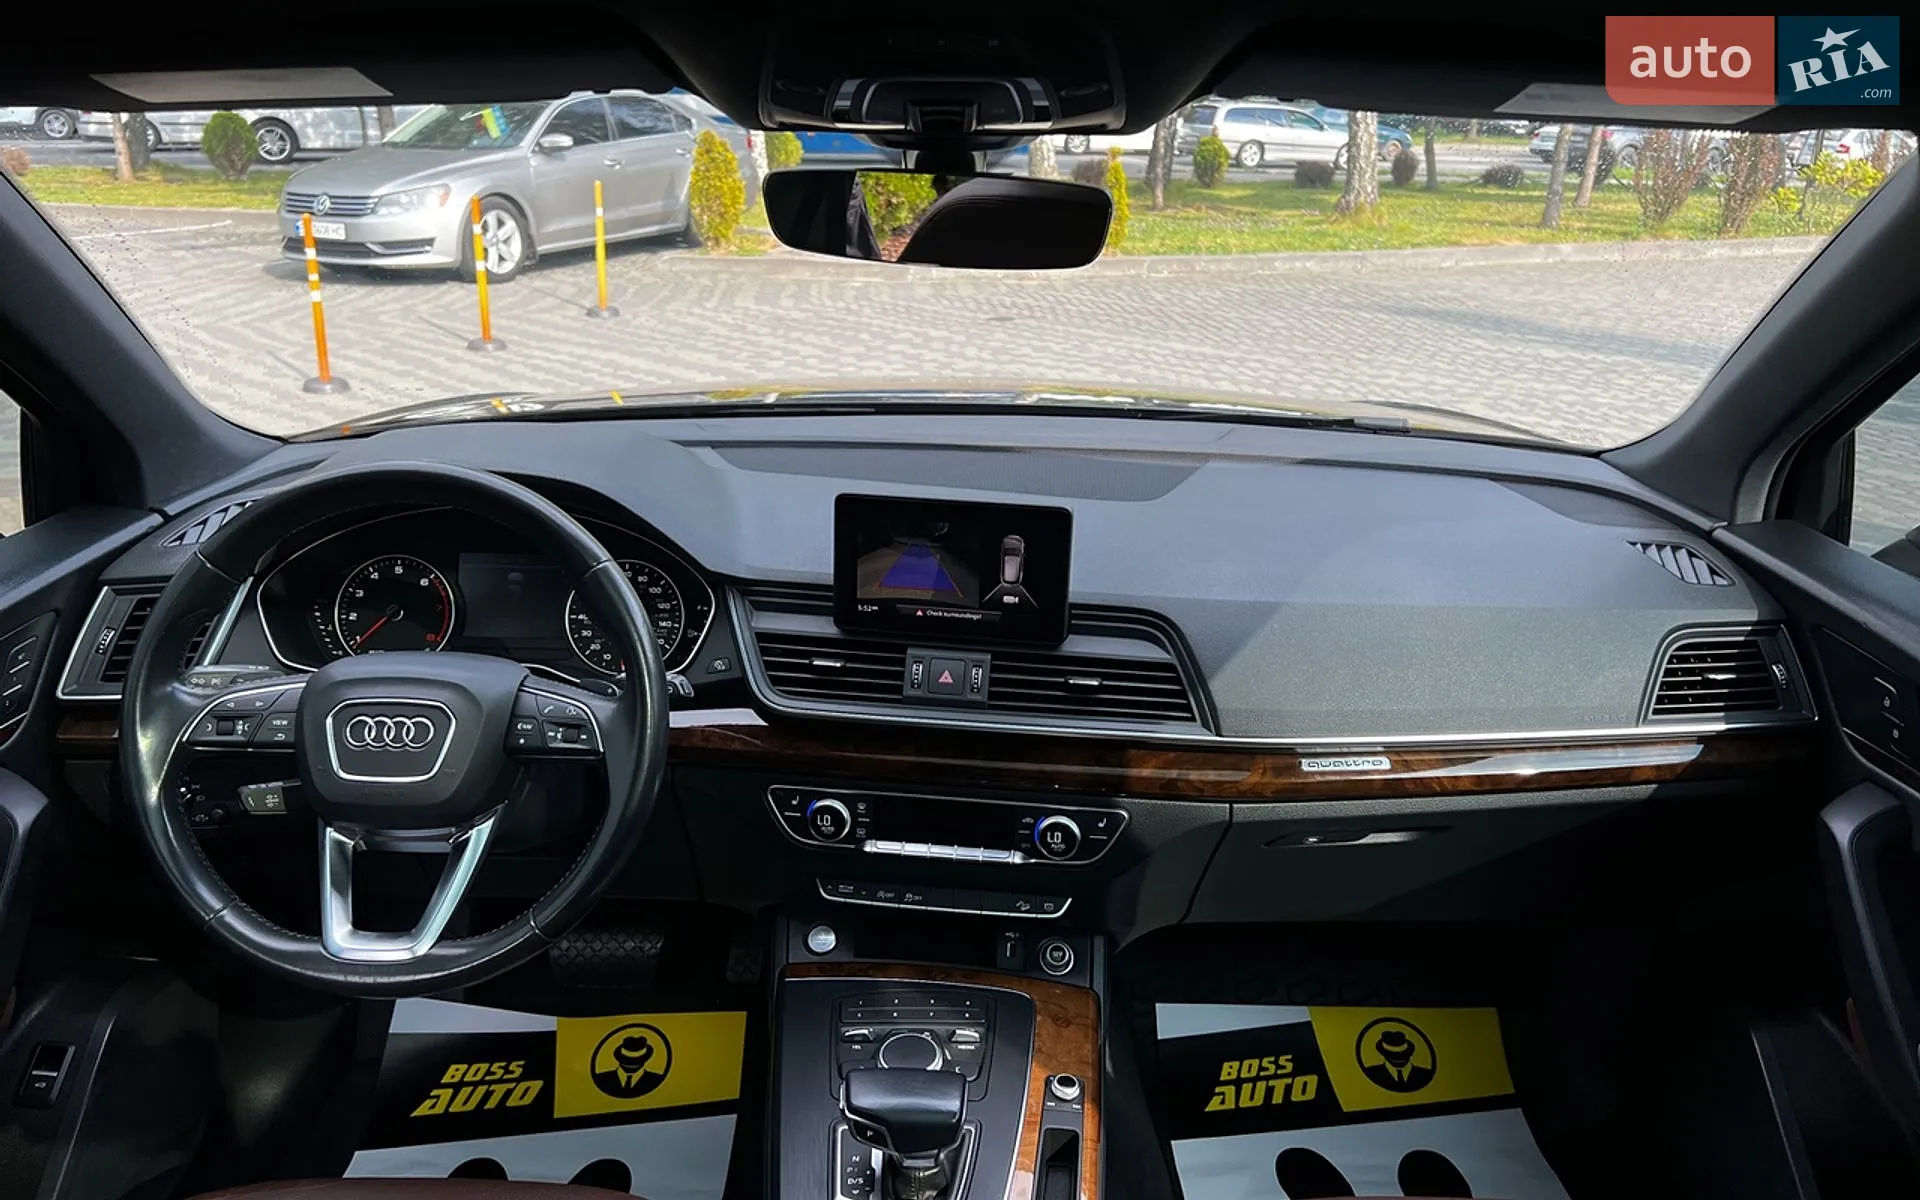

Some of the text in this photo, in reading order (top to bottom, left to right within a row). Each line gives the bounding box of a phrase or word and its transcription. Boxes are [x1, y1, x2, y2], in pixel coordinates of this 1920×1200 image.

[394, 565, 403, 574] 5
[370, 572, 379, 580] 4
[637, 575, 648, 583] 80
[420, 577, 429, 586] 6
[355, 589, 364, 598] 3
[657, 602, 671, 610] 120
[348, 612, 358, 621] 2
[926, 609, 943, 617] Check
[658, 620, 672, 628] 140
[581, 629, 593, 638] 30
[590, 643, 601, 651] 20
[272, 719, 289, 727] VIEW
[1307, 760, 1384, 769] quattro
[817, 814, 831, 826] LO
[1046, 831, 1062, 843] LO
[1219, 1054, 1293, 1081] BOSS
[440, 1060, 525, 1085] BOSS
[1203, 1074, 1318, 1112] AUTO
[409, 1079, 544, 1117] AUTO
[867, 1129, 874, 1137] P
